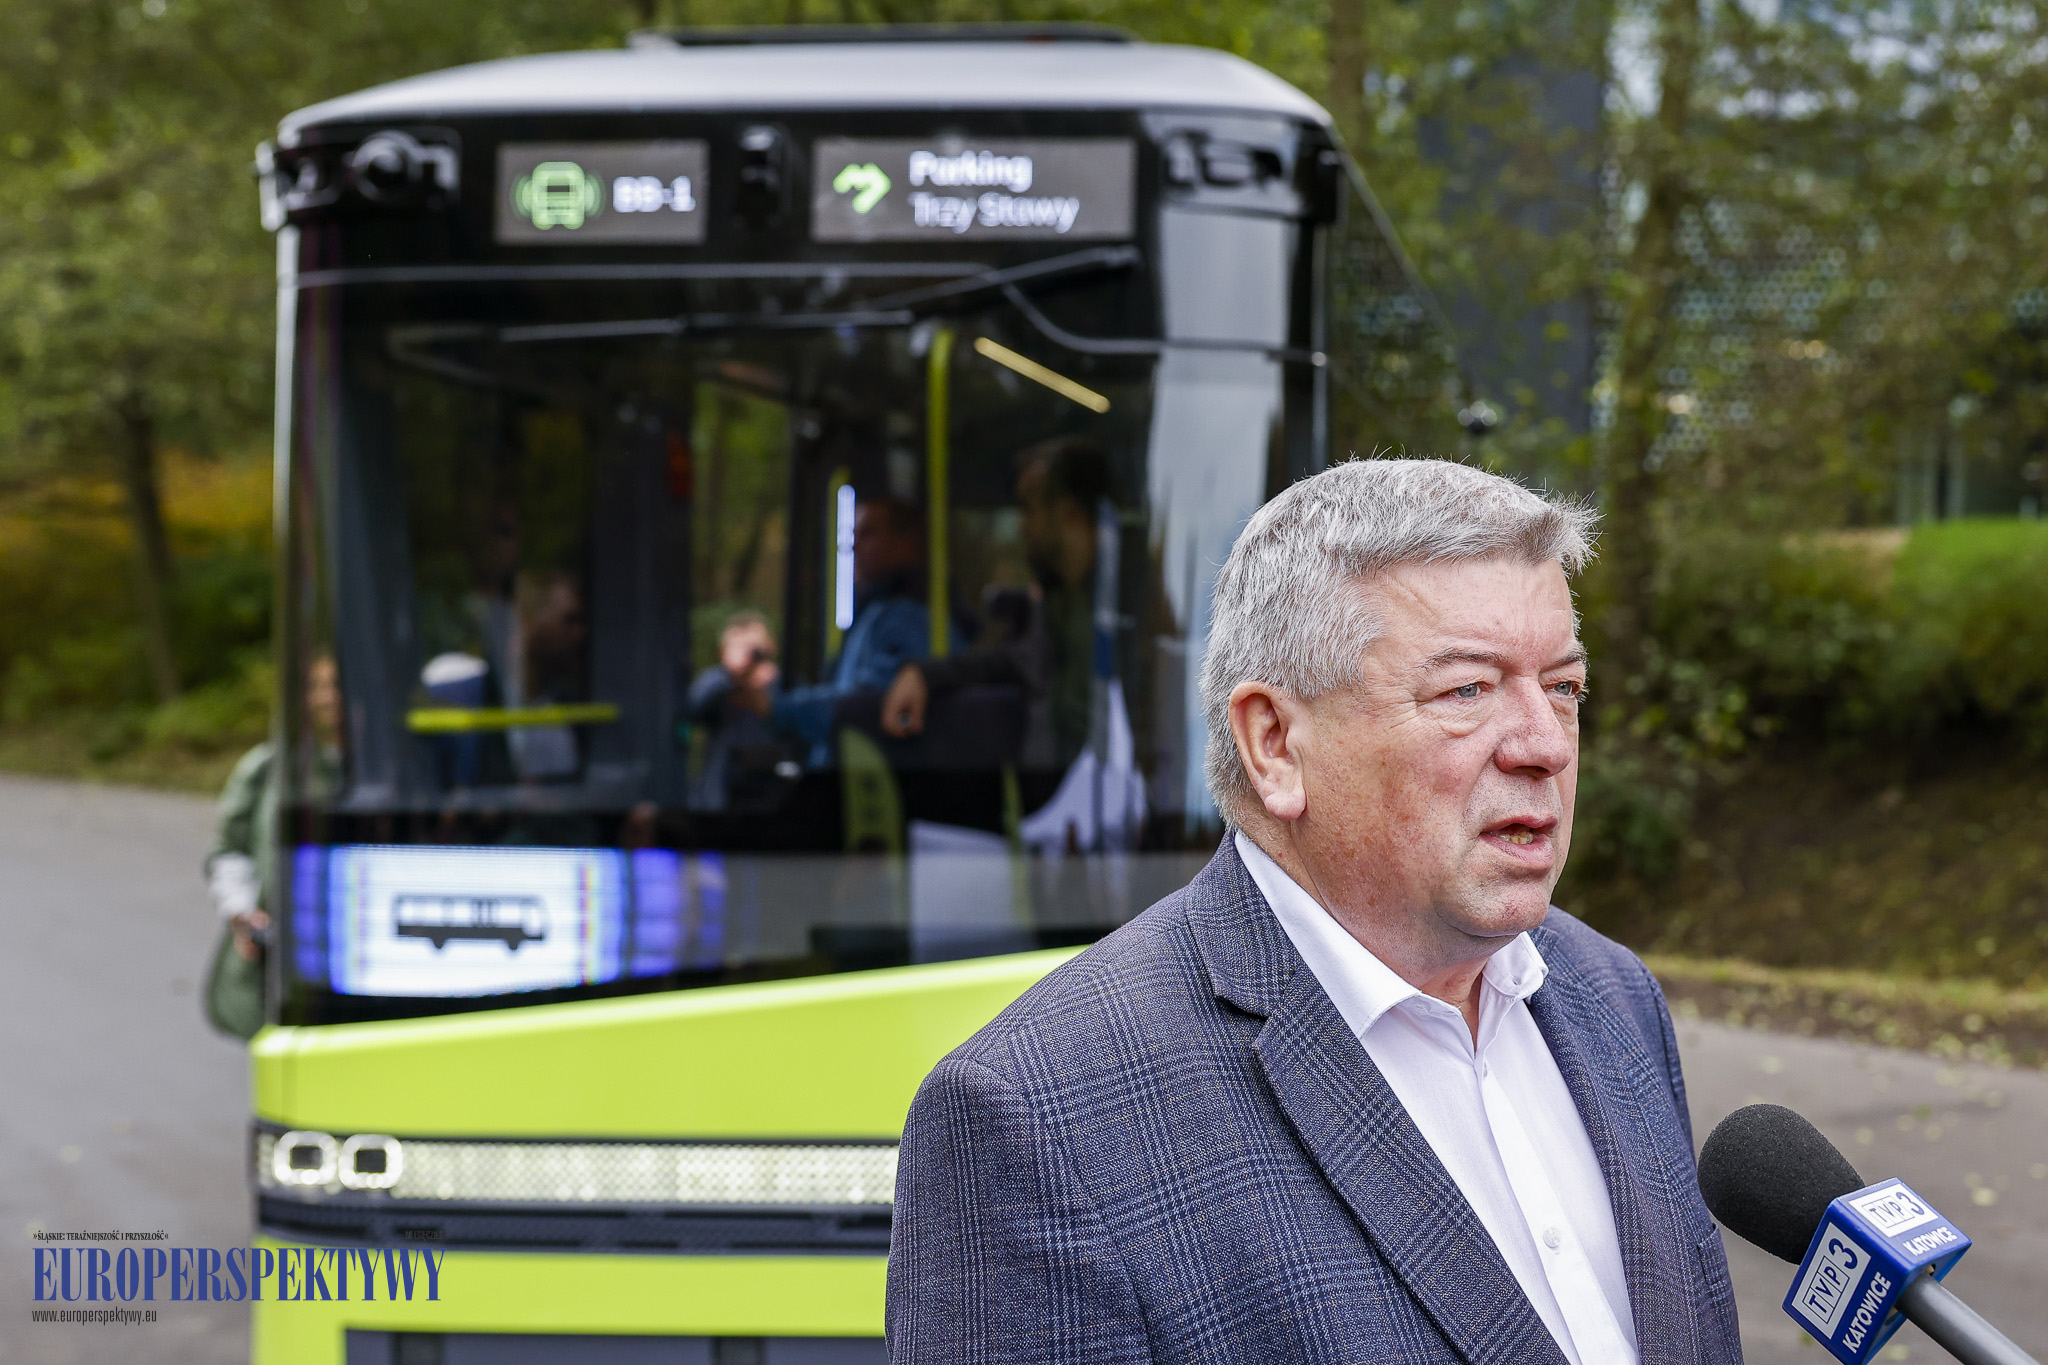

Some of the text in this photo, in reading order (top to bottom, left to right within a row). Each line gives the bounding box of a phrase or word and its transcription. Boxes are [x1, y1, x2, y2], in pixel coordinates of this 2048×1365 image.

[910, 150, 1033, 193] Parking
[908, 191, 977, 234] Trzy
[1902, 1226, 1958, 1257] KATOWICE
[1842, 1271, 1892, 1354] KATOWICE
